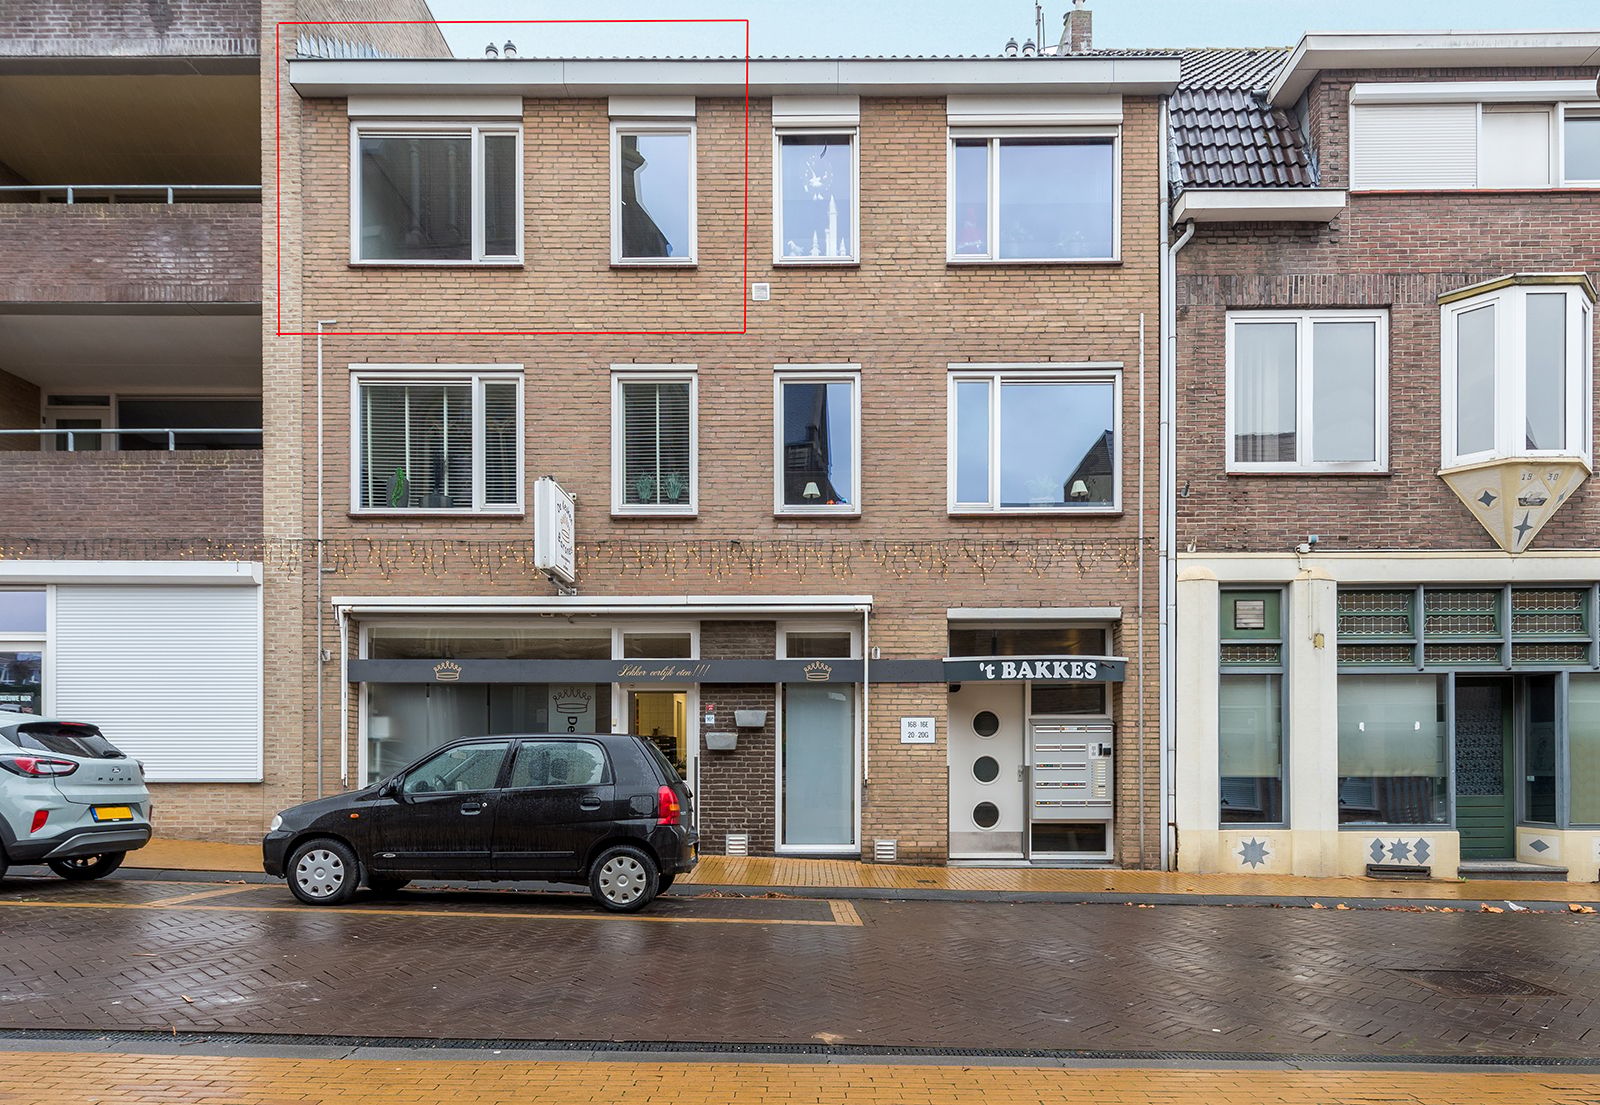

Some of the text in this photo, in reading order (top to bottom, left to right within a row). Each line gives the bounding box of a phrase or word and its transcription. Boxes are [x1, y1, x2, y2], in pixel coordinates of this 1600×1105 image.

[617, 663, 646, 677] Lekker
[649, 665, 676, 680] eerlijk
[979, 661, 1097, 679] 't BAKKES
